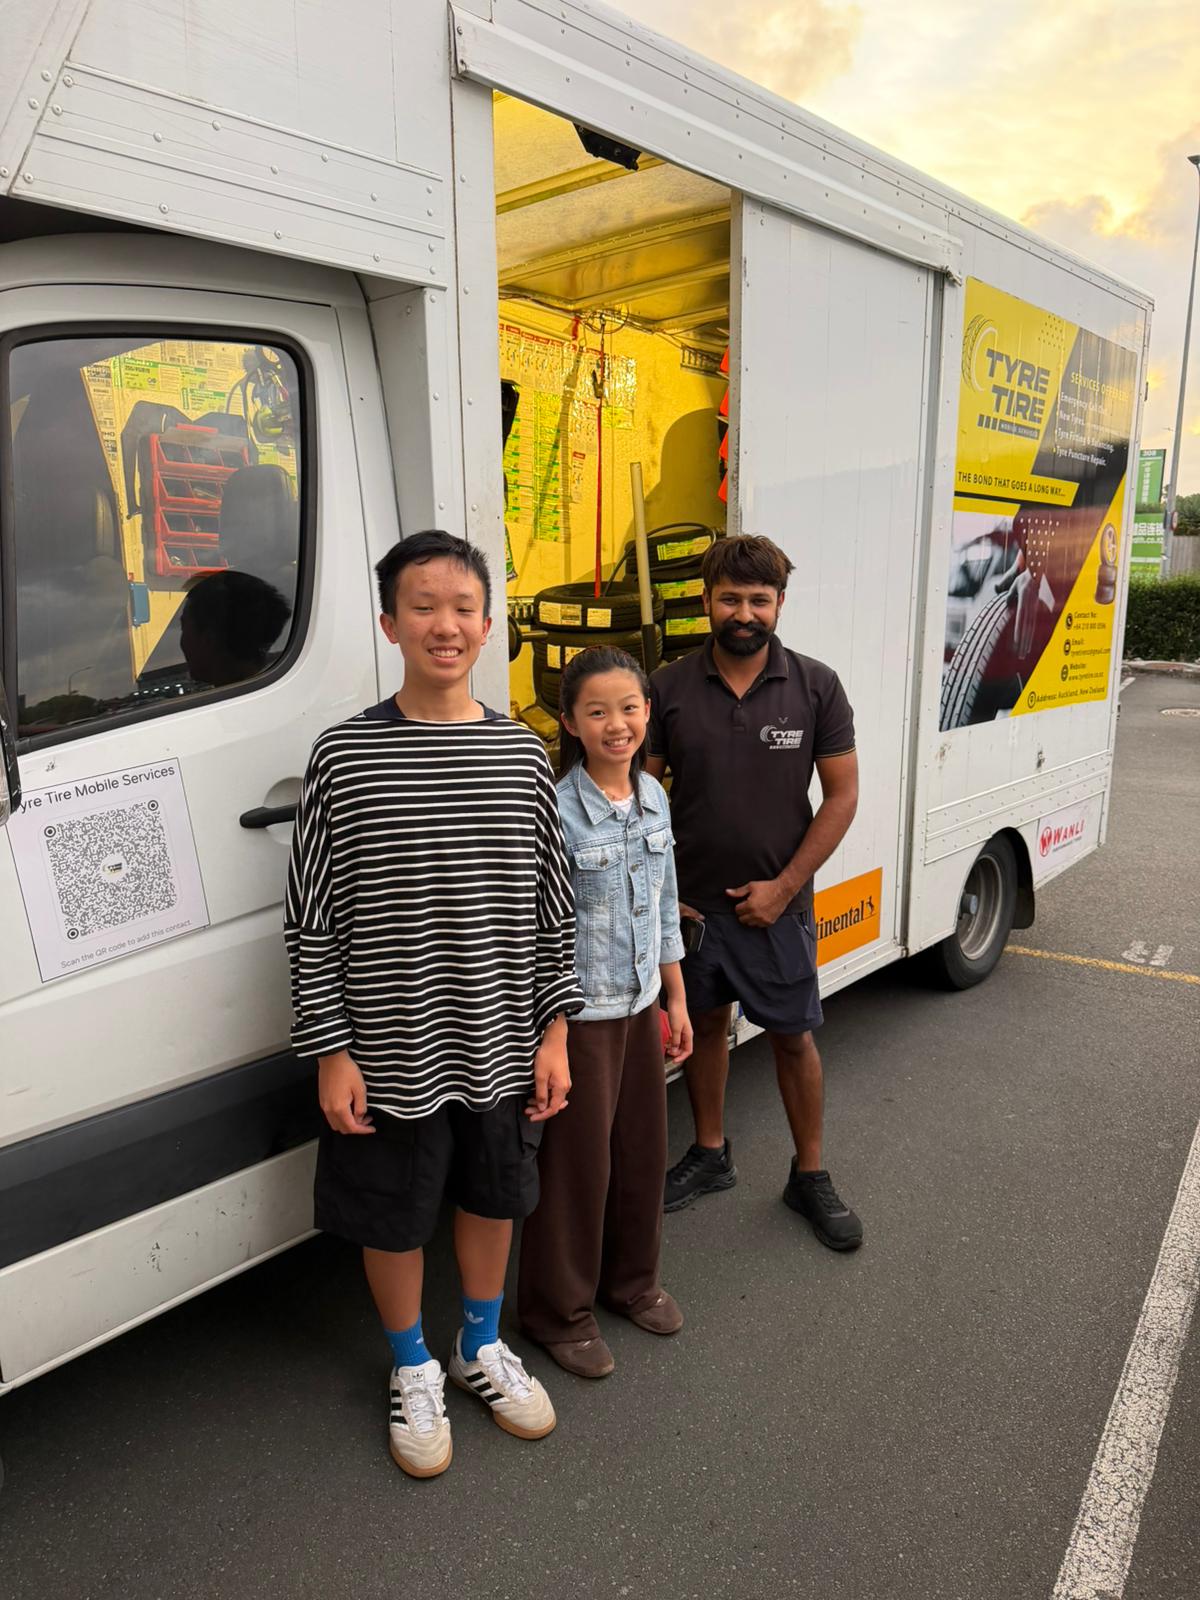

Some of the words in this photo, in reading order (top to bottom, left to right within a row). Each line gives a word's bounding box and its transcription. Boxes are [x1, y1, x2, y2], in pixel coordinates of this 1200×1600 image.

[986, 348, 1050, 394] TYRE
[1071, 372, 1099, 392] SERVICES
[991, 384, 1045, 424] TIRE
[1061, 392, 1088, 408] Emergency
[1060, 410, 1070, 421] New
[1058, 428, 1069, 440] Tyre
[1070, 431, 1086, 446] Fitting
[1057, 446, 1067, 457] Tyre
[1068, 448, 1090, 462] Puncture
[958, 471, 971, 483] THE
[973, 474, 993, 486] BOND
[994, 477, 1010, 488] THAT
[1011, 480, 1027, 491] GOES
[1028, 483, 1033, 492] A
[1034, 485, 1049, 494] LONG
[1089, 686, 1105, 694] Zealand
[770, 730, 804, 738] TYRE
[20, 797, 42, 814] yre
[45, 790, 72, 805] Tire
[75, 779, 119, 798] Mobile
[122, 766, 175, 786] Services
[1053, 819, 1085, 846] WANLI
[61, 958, 80, 969] Scan
[81, 953, 94, 962] the
[95, 948, 107, 957] QR
[108, 943, 126, 952] code
[137, 933, 150, 943] add
[151, 929, 164, 938] this
[166, 920, 192, 933] contact
